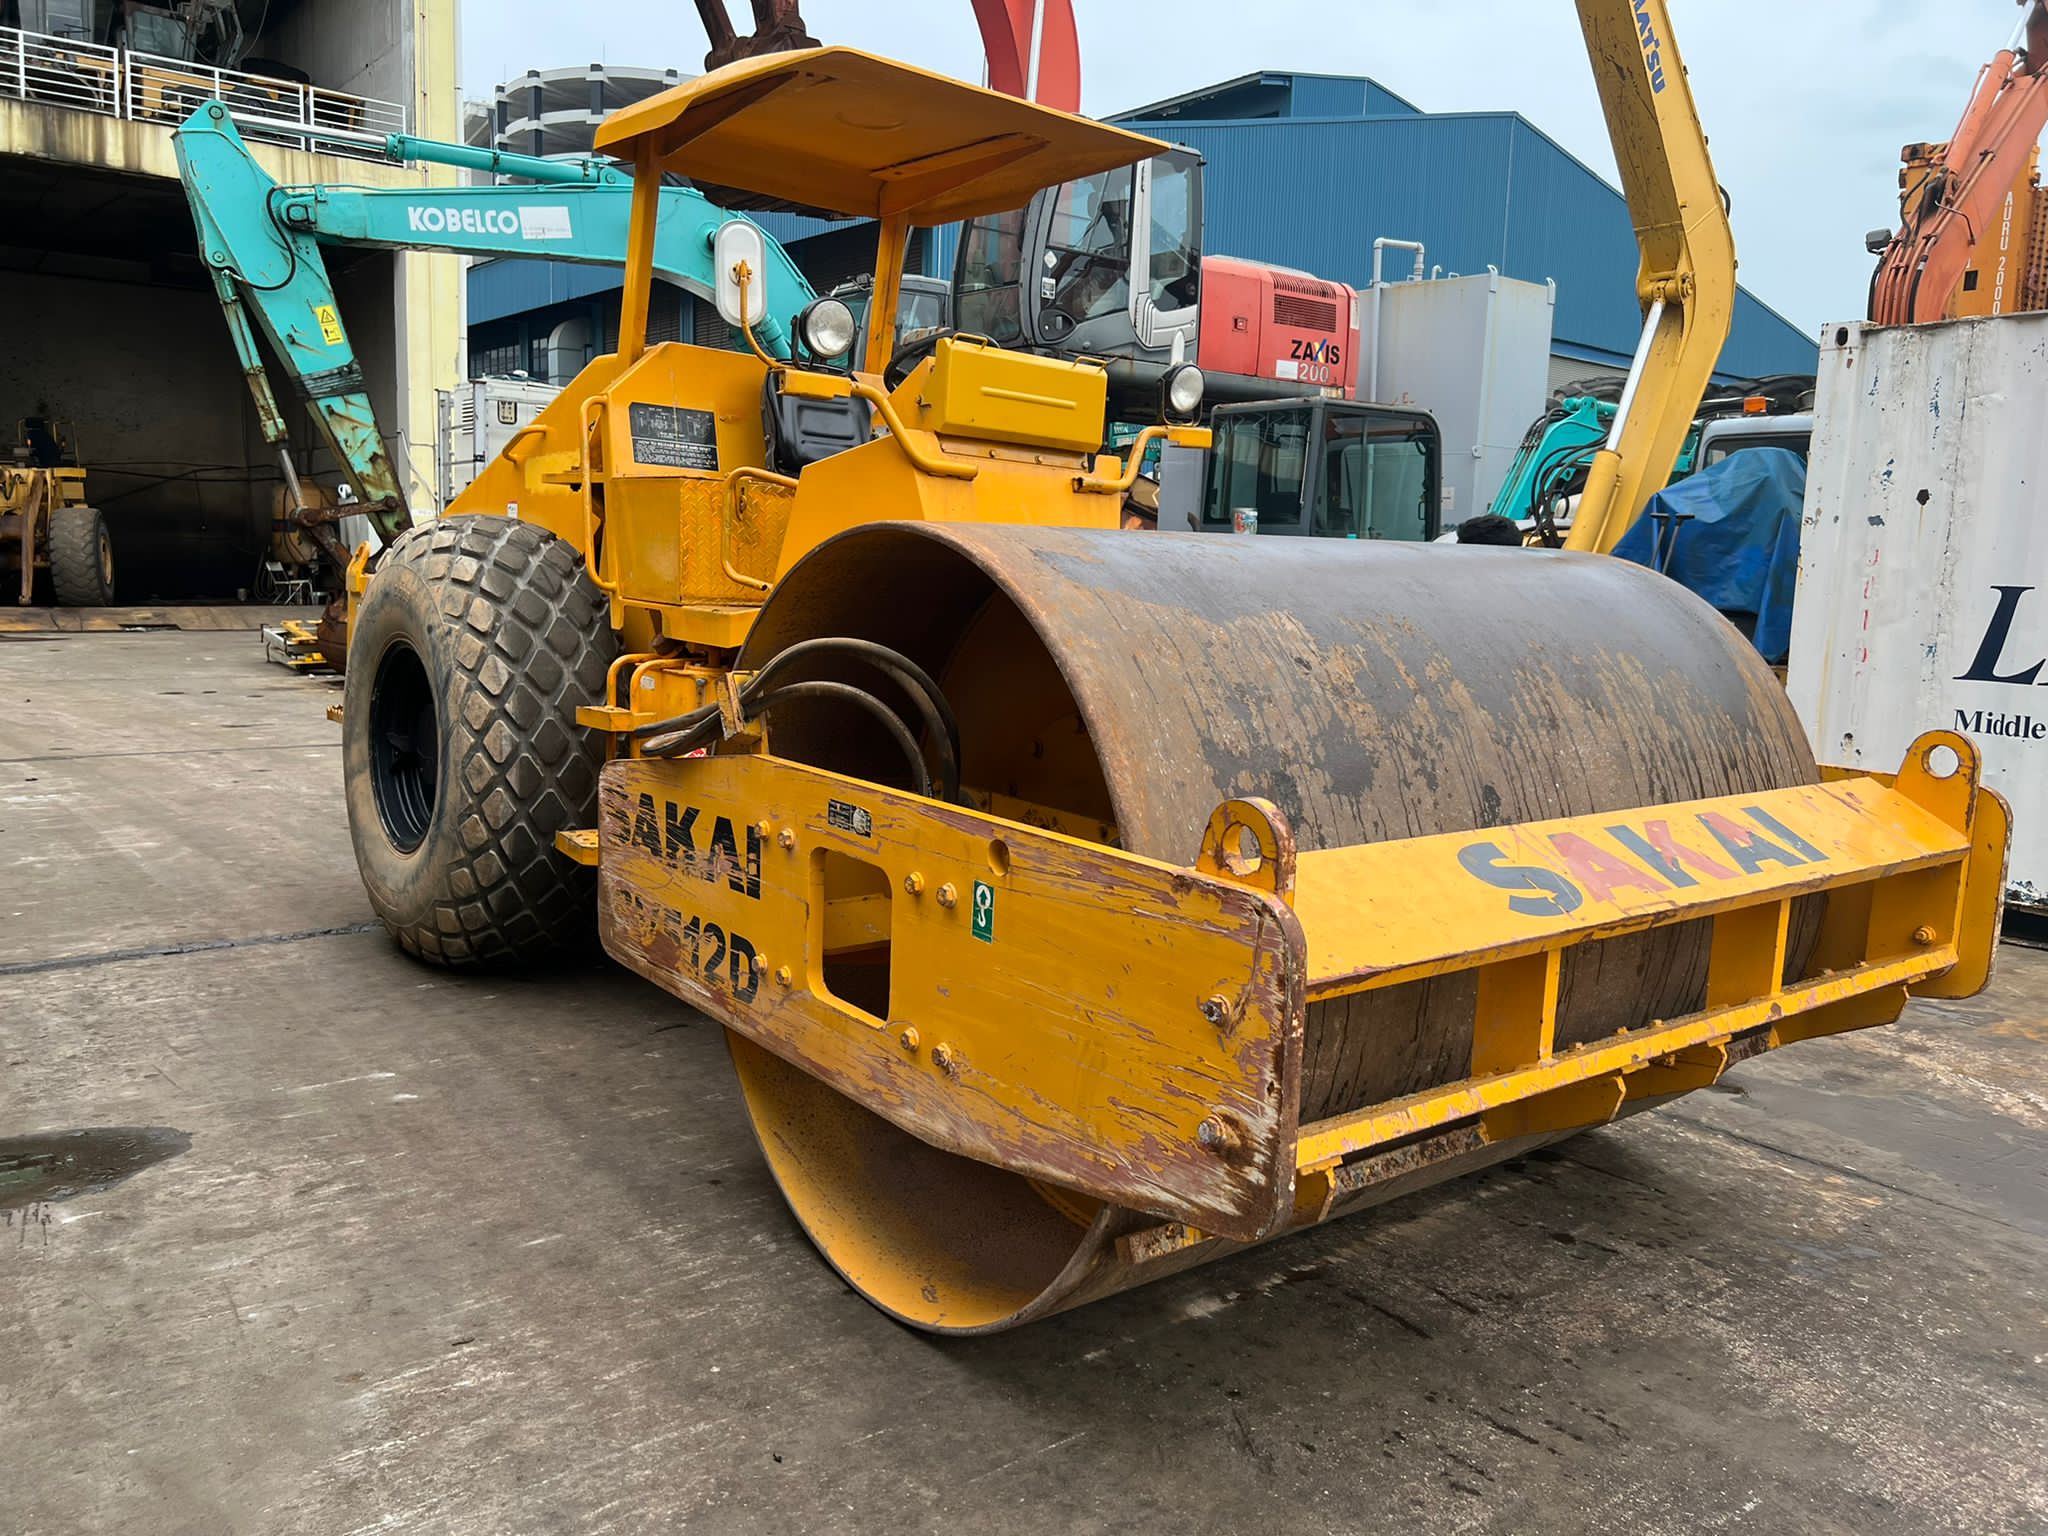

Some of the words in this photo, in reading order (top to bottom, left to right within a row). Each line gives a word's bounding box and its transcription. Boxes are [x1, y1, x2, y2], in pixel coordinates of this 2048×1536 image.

[408, 207, 519, 235] KOBELCO
[1992, 256, 2006, 316] 2000
[1291, 338, 1340, 365] ZAXIS
[1299, 363, 1329, 383] 200
[1952, 585, 2048, 686] L
[1954, 708, 2047, 740] Middle
[1457, 806, 1831, 917] SAKAI
